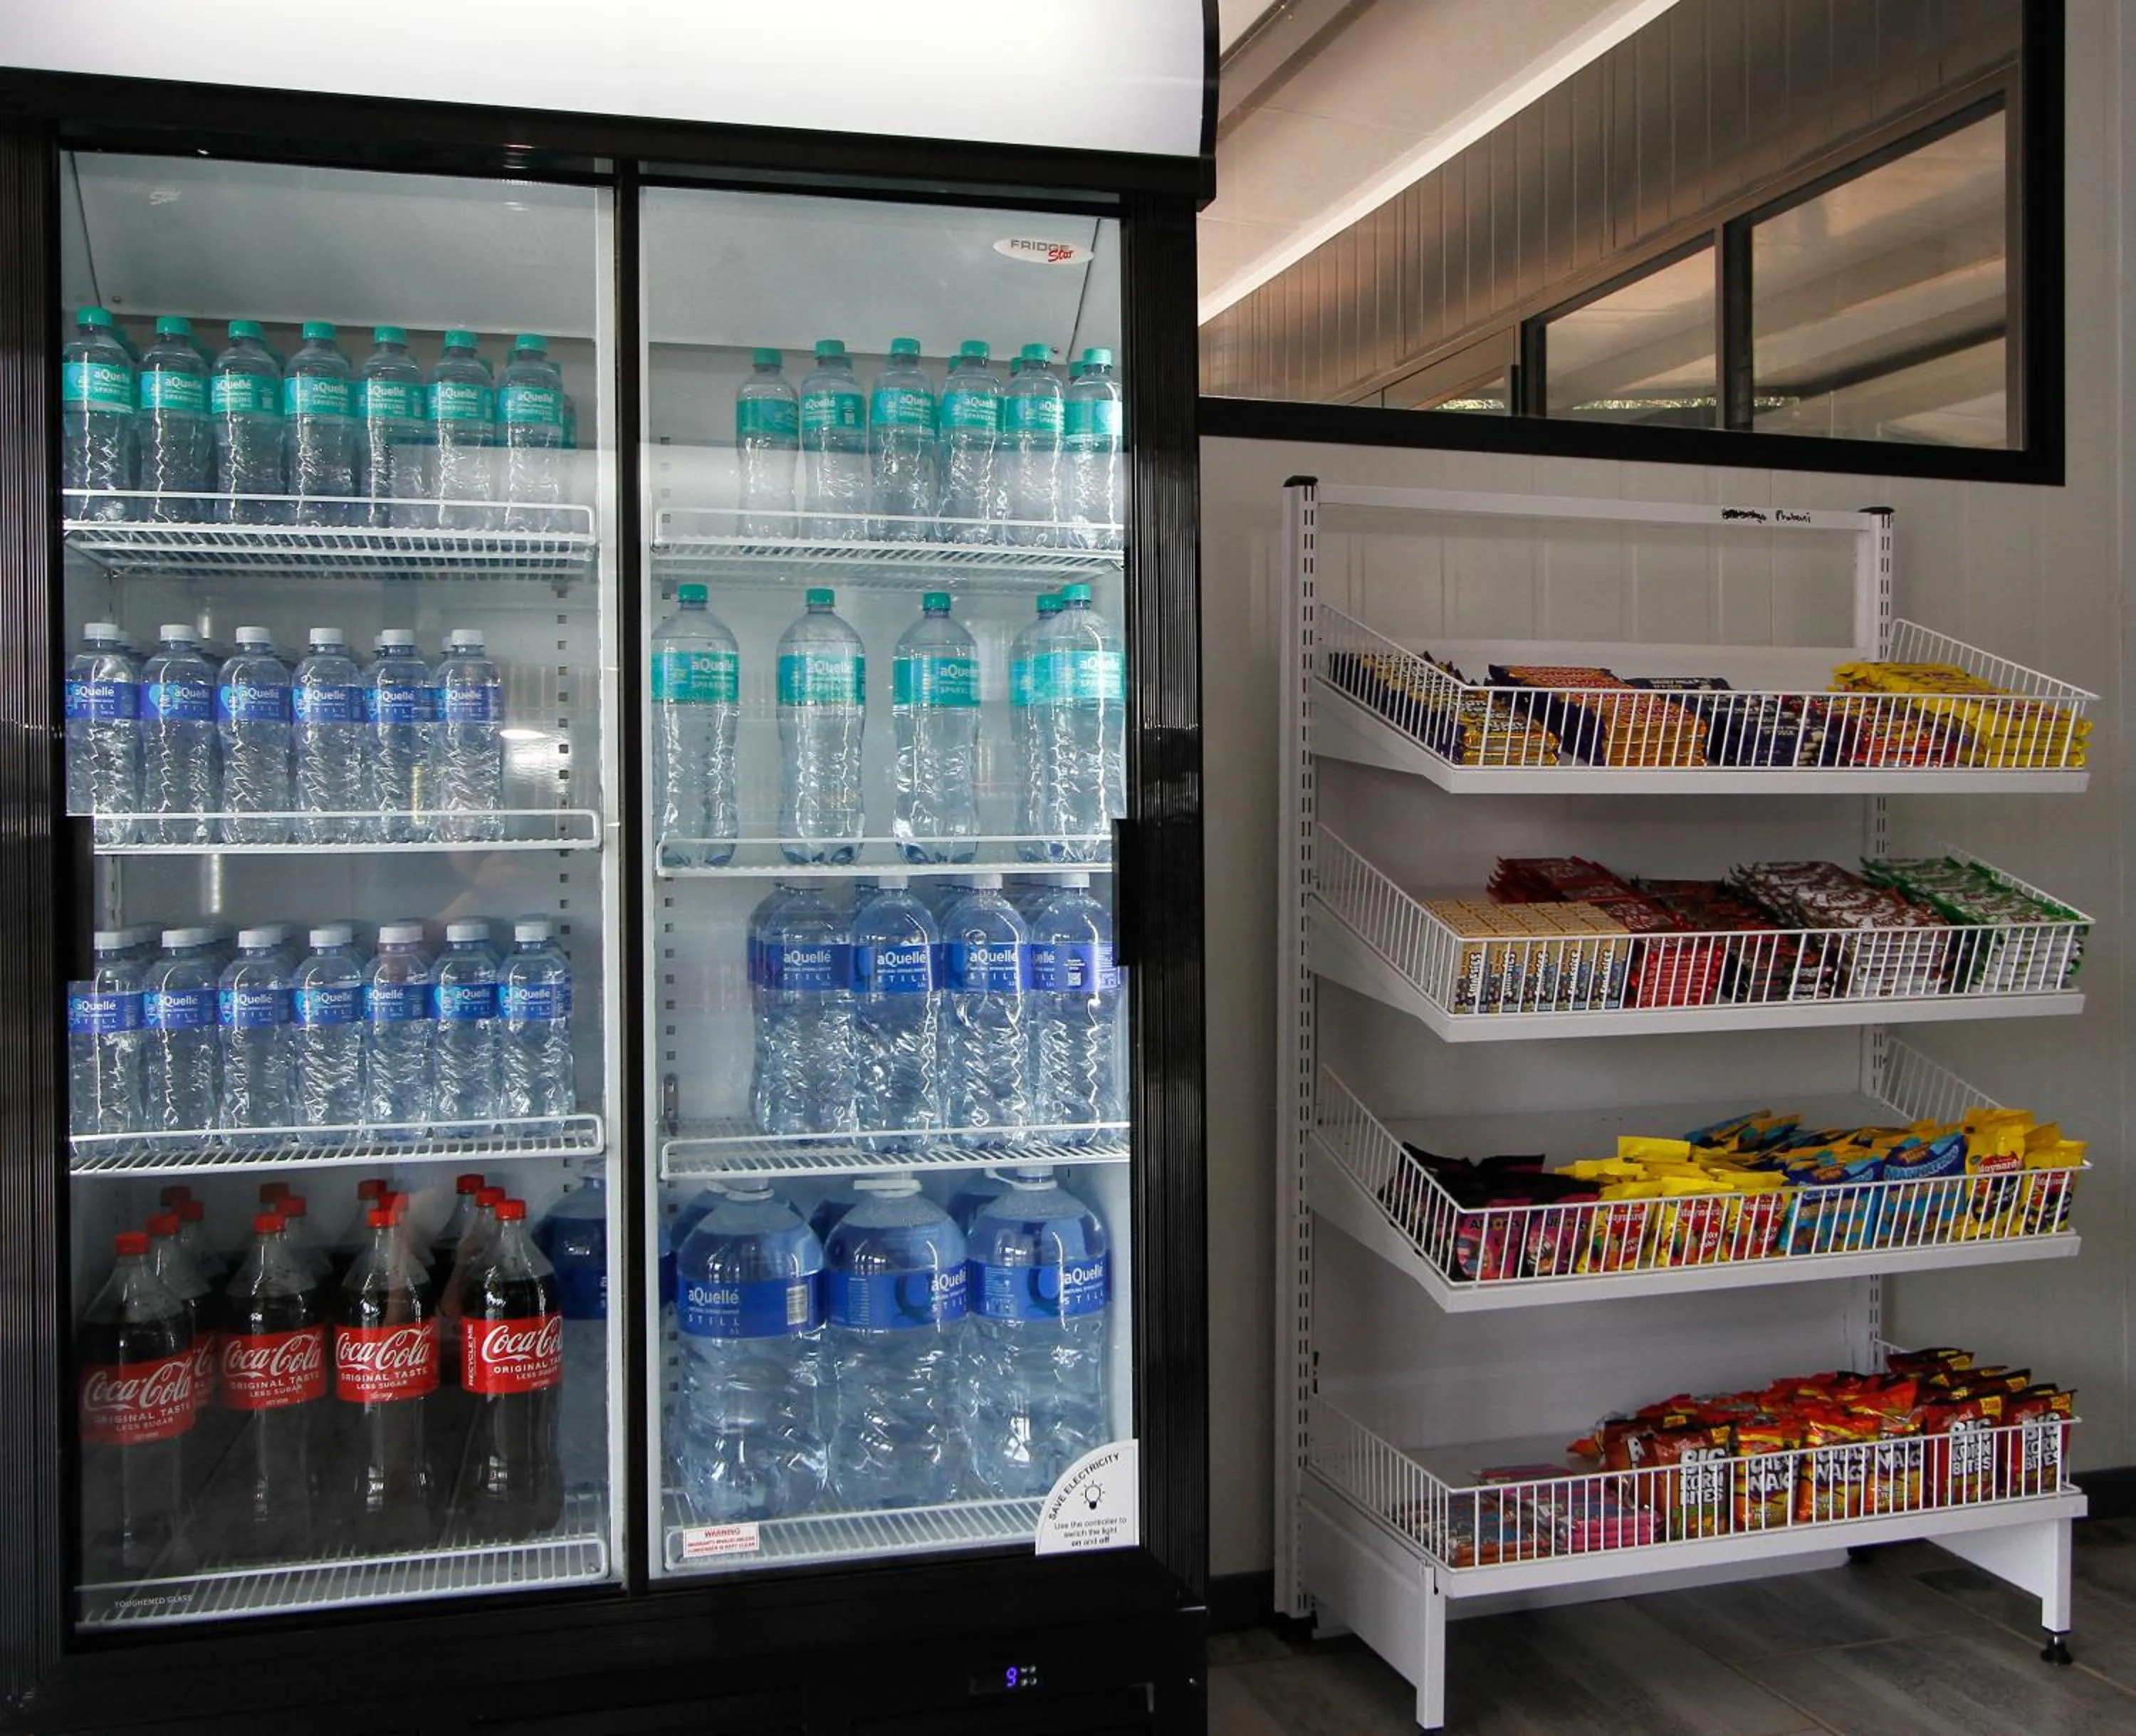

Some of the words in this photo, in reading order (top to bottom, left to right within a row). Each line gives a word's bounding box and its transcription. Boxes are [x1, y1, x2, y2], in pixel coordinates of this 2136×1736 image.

[1010, 239, 1069, 251] FRIDGE
[335, 1326, 431, 1371] Coca-Cola
[482, 1315, 562, 1364] Coca-Col
[223, 1333, 321, 1378] Coca-Cola
[341, 1372, 389, 1383] ORIGINAL
[395, 1366, 427, 1379] TASTE
[493, 1361, 546, 1374] ORIGINAL
[83, 1360, 192, 1412] Coca-Cola
[1680, 1448, 1725, 1474] BIG
[1048, 1495, 1067, 1521] SAVE
[1064, 1452, 1120, 1495] ELECTRICITY
[1749, 1471, 1794, 1492] NAK
[704, 1527, 741, 1537] WARNING
[167, 1594, 193, 1603] GLASS
[1006, 1666, 1018, 1688] 9
